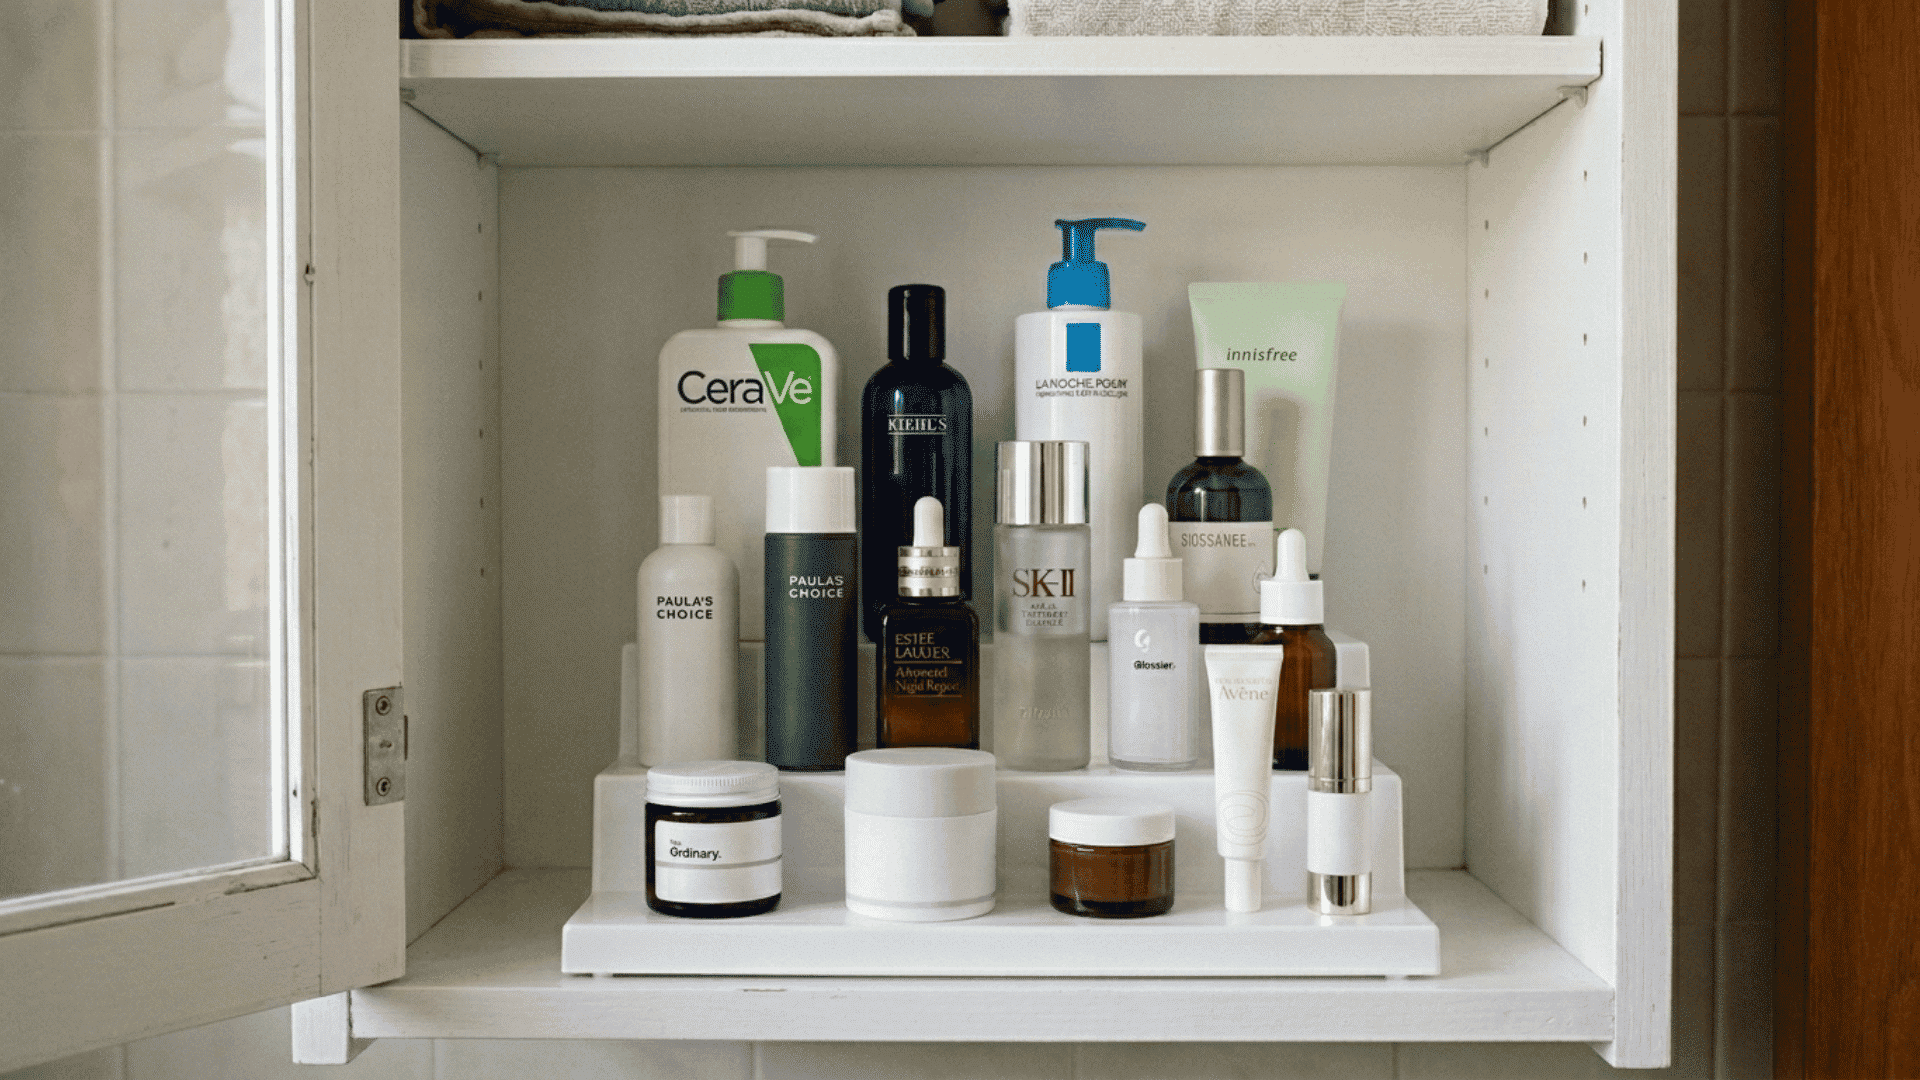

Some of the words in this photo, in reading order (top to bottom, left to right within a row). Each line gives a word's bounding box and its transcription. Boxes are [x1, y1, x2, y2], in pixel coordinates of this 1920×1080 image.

[1226, 347, 1297, 361] innisfree
[677, 370, 812, 404] CeraVe
[1013, 569, 1075, 597] SK-II
[789, 588, 844, 599] CHOICE
[657, 596, 713, 607] PAULA'S
[657, 609, 713, 620] CHOICE
